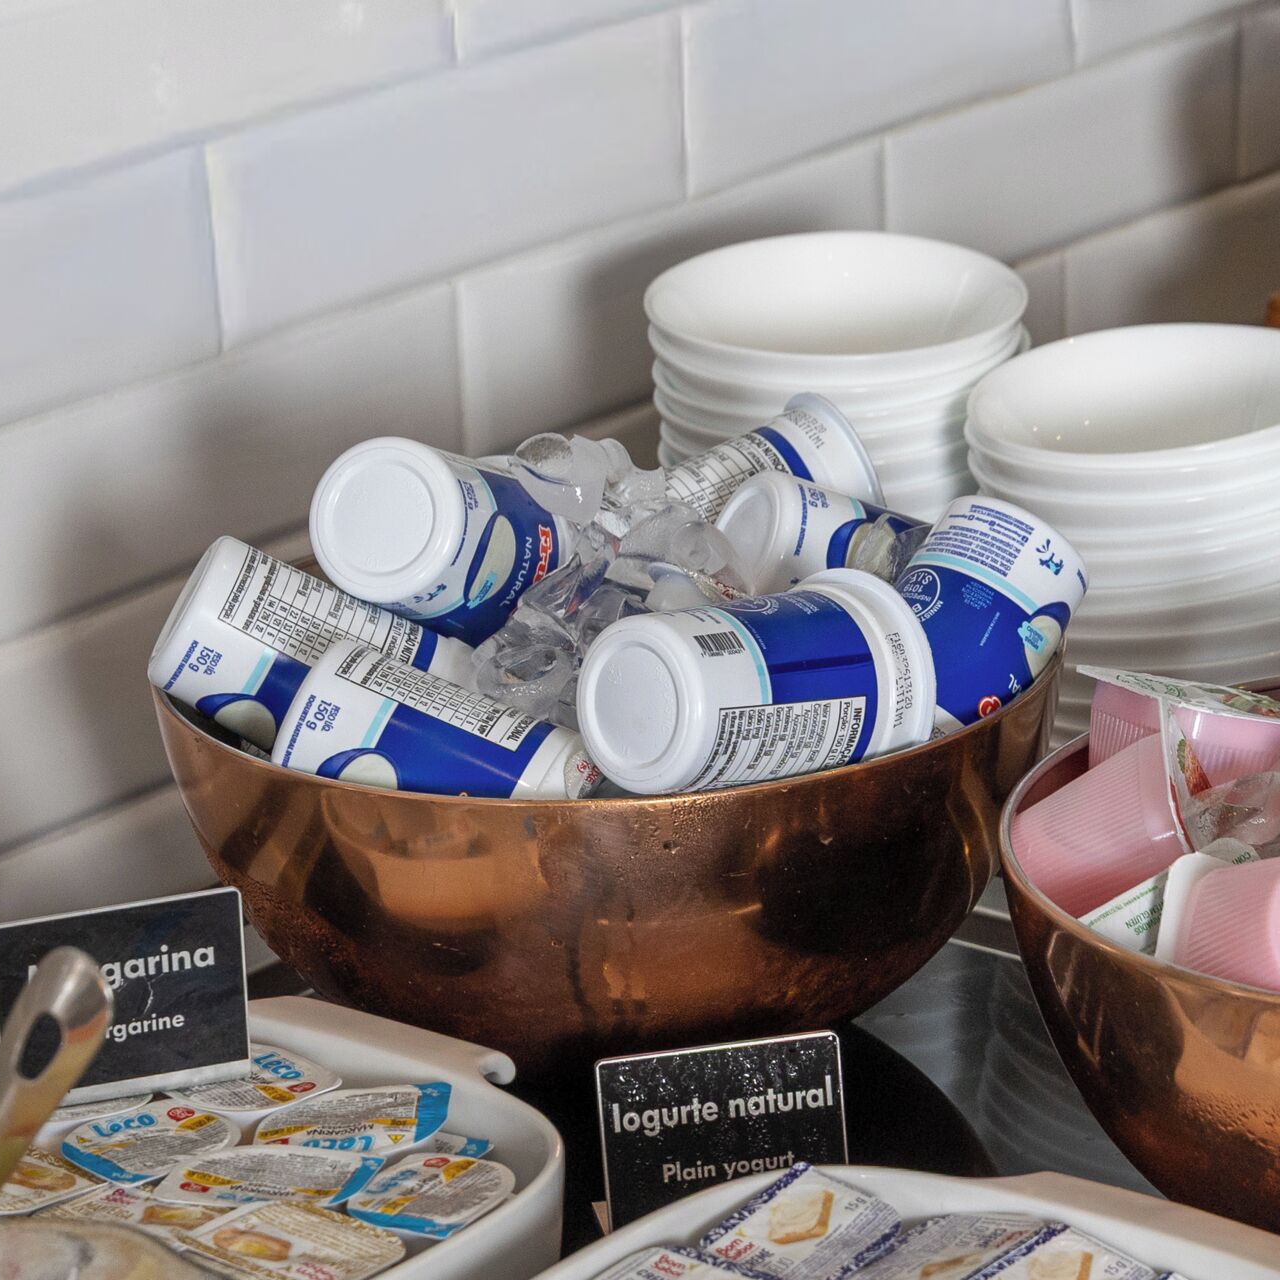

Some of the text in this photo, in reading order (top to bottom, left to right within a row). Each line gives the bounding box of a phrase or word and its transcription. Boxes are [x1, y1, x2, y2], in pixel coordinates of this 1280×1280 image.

[499, 535, 534, 609] NATURAL
[186, 644, 214, 673] 150 g
[208, 650, 223, 668] PESO
[304, 697, 332, 731] 150 g
[325, 703, 341, 722] PESO
[105, 1013, 186, 1043] rgarine
[612, 1074, 835, 1137] Iogurte natural
[663, 1151, 796, 1183] Plain yogurt
